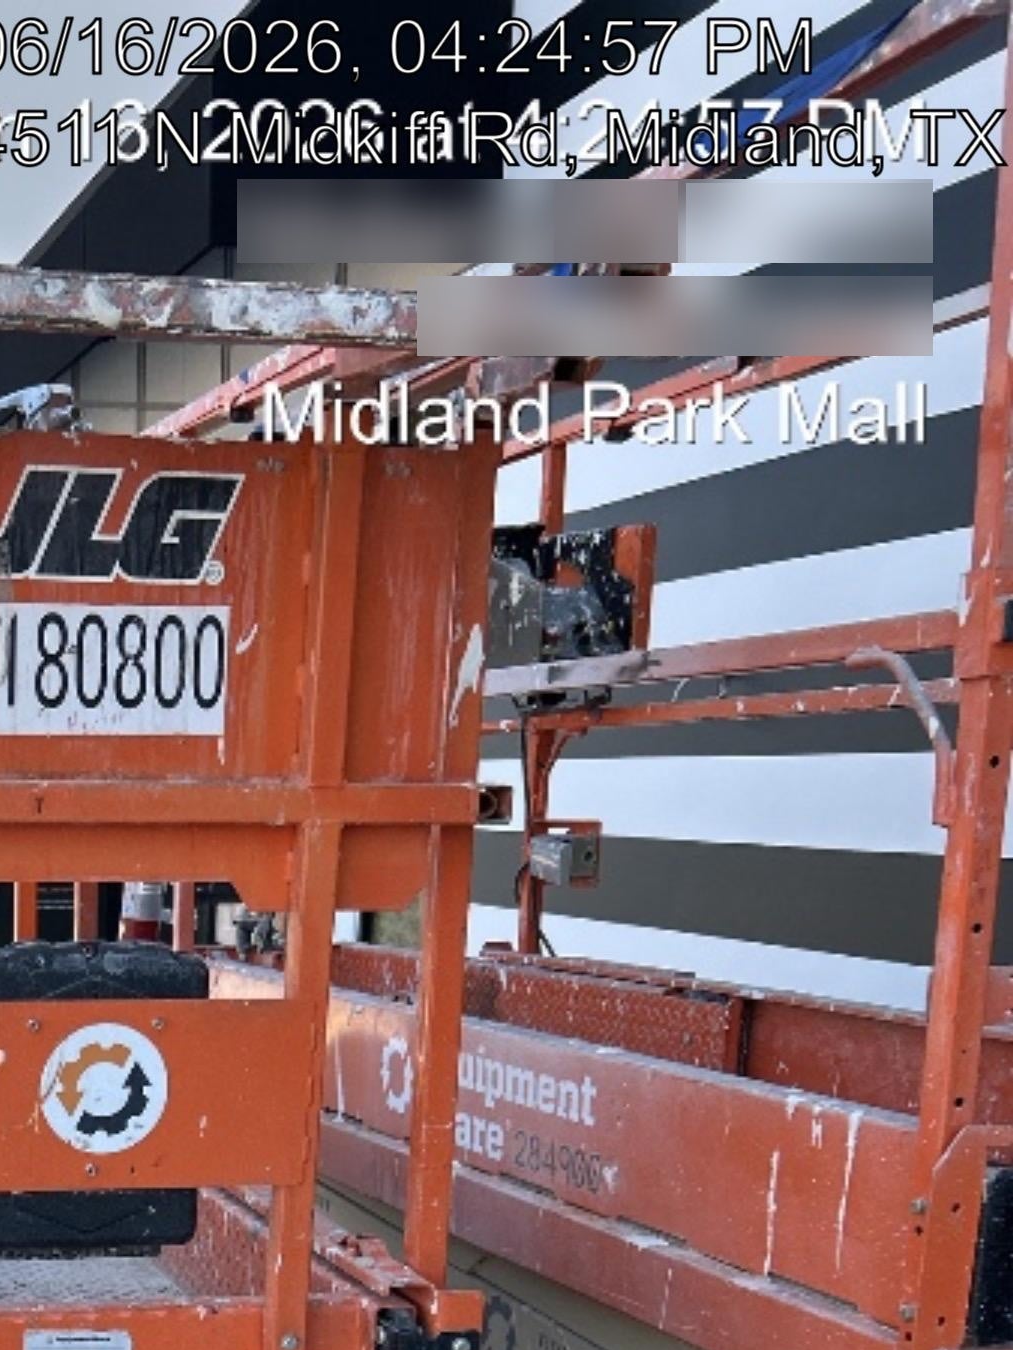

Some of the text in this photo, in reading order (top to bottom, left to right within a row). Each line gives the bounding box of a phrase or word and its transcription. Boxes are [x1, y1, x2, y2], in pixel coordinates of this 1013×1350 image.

[5, 611, 224, 709] 180800
[458, 1045, 597, 1126] uipment
[454, 1111, 505, 1161] are
